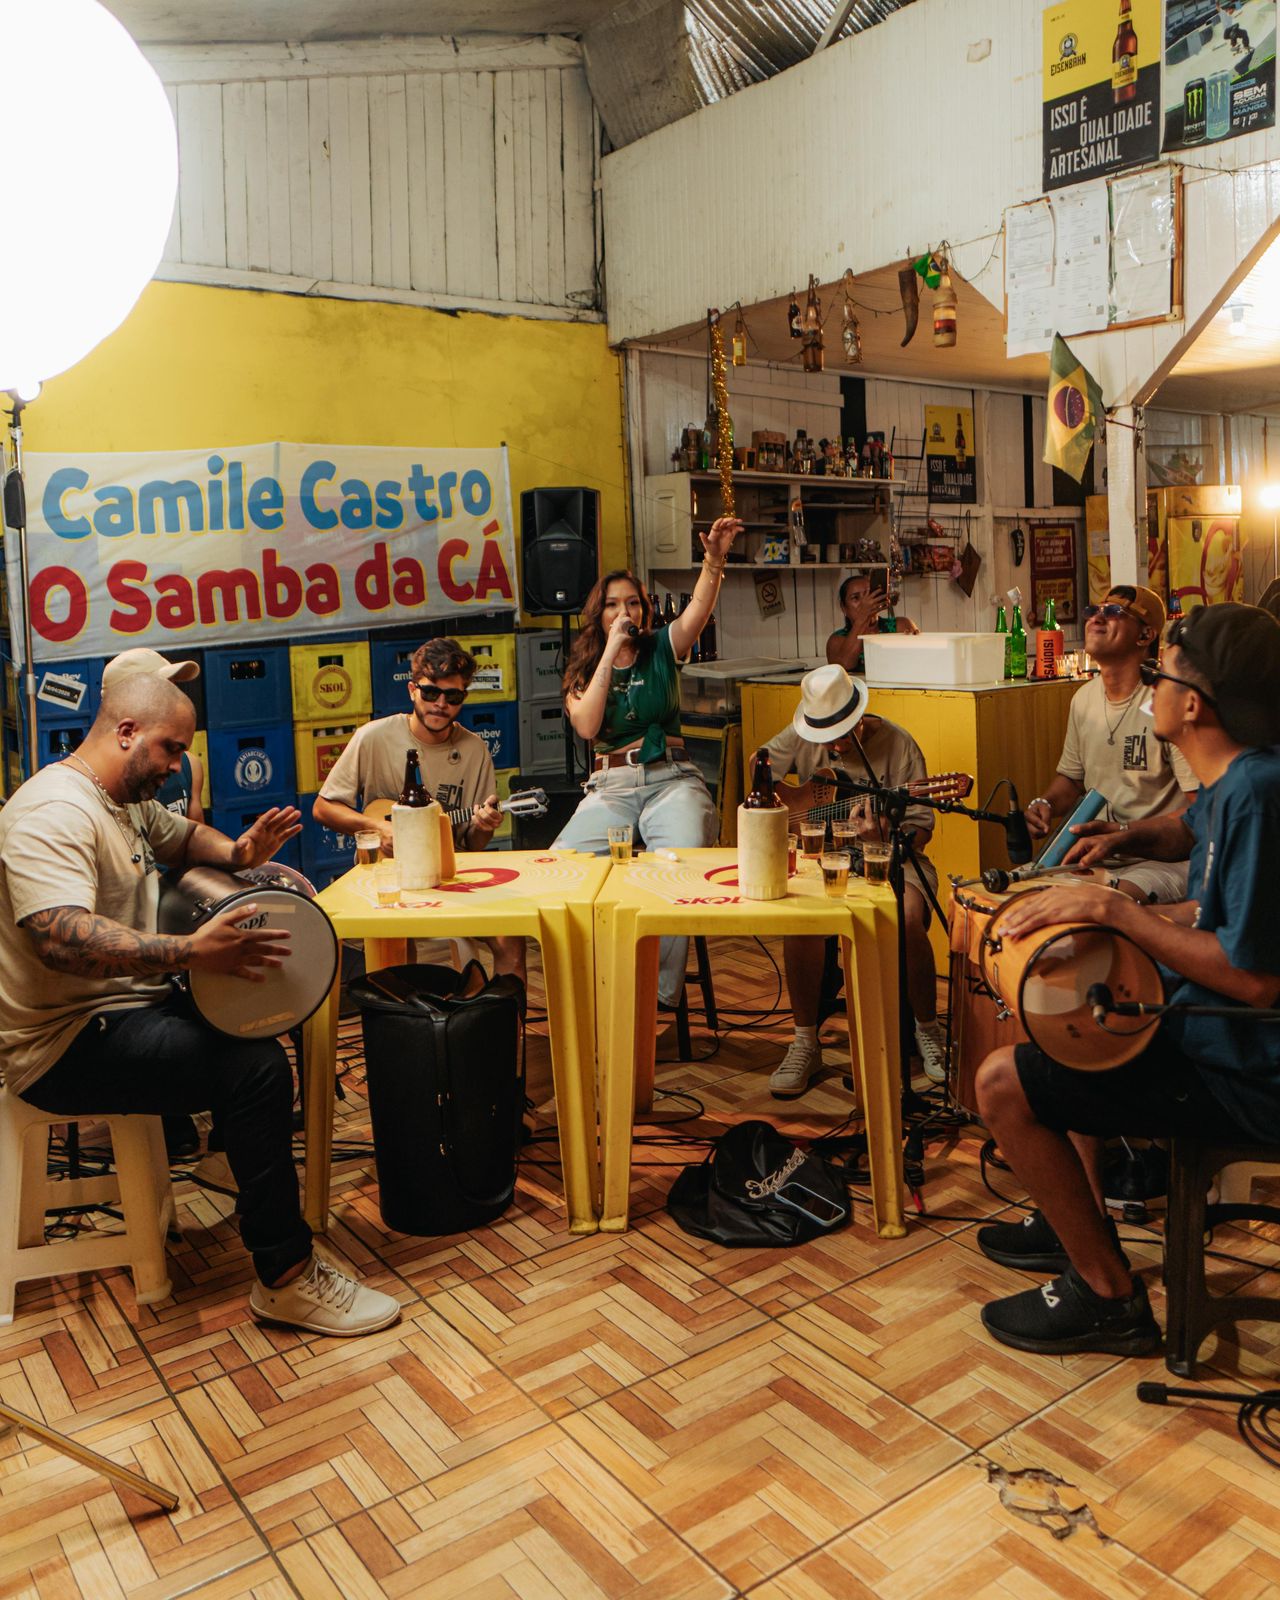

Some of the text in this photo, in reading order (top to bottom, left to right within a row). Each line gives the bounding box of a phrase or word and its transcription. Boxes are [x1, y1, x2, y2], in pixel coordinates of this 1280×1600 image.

[1051, 53, 1086, 76] EISENBAHN
[1233, 83, 1267, 101] SEM
[1051, 96, 1088, 131] ISSO É
[1233, 101, 1268, 117] MANGO
[1080, 101, 1152, 147] QUALIDADE
[1050, 138, 1122, 179] ARTESANAL
[42, 454, 492, 539] Camile Castro
[30, 519, 513, 642] O Samba da CÁ
[393, 671, 413, 681] amb
[319, 683, 345, 693] SKOL
[477, 729, 501, 739] mbev
[1132, 726, 1148, 770] CÁ
[674, 896, 743, 905] SKOL
[239, 912, 269, 929] OPE
